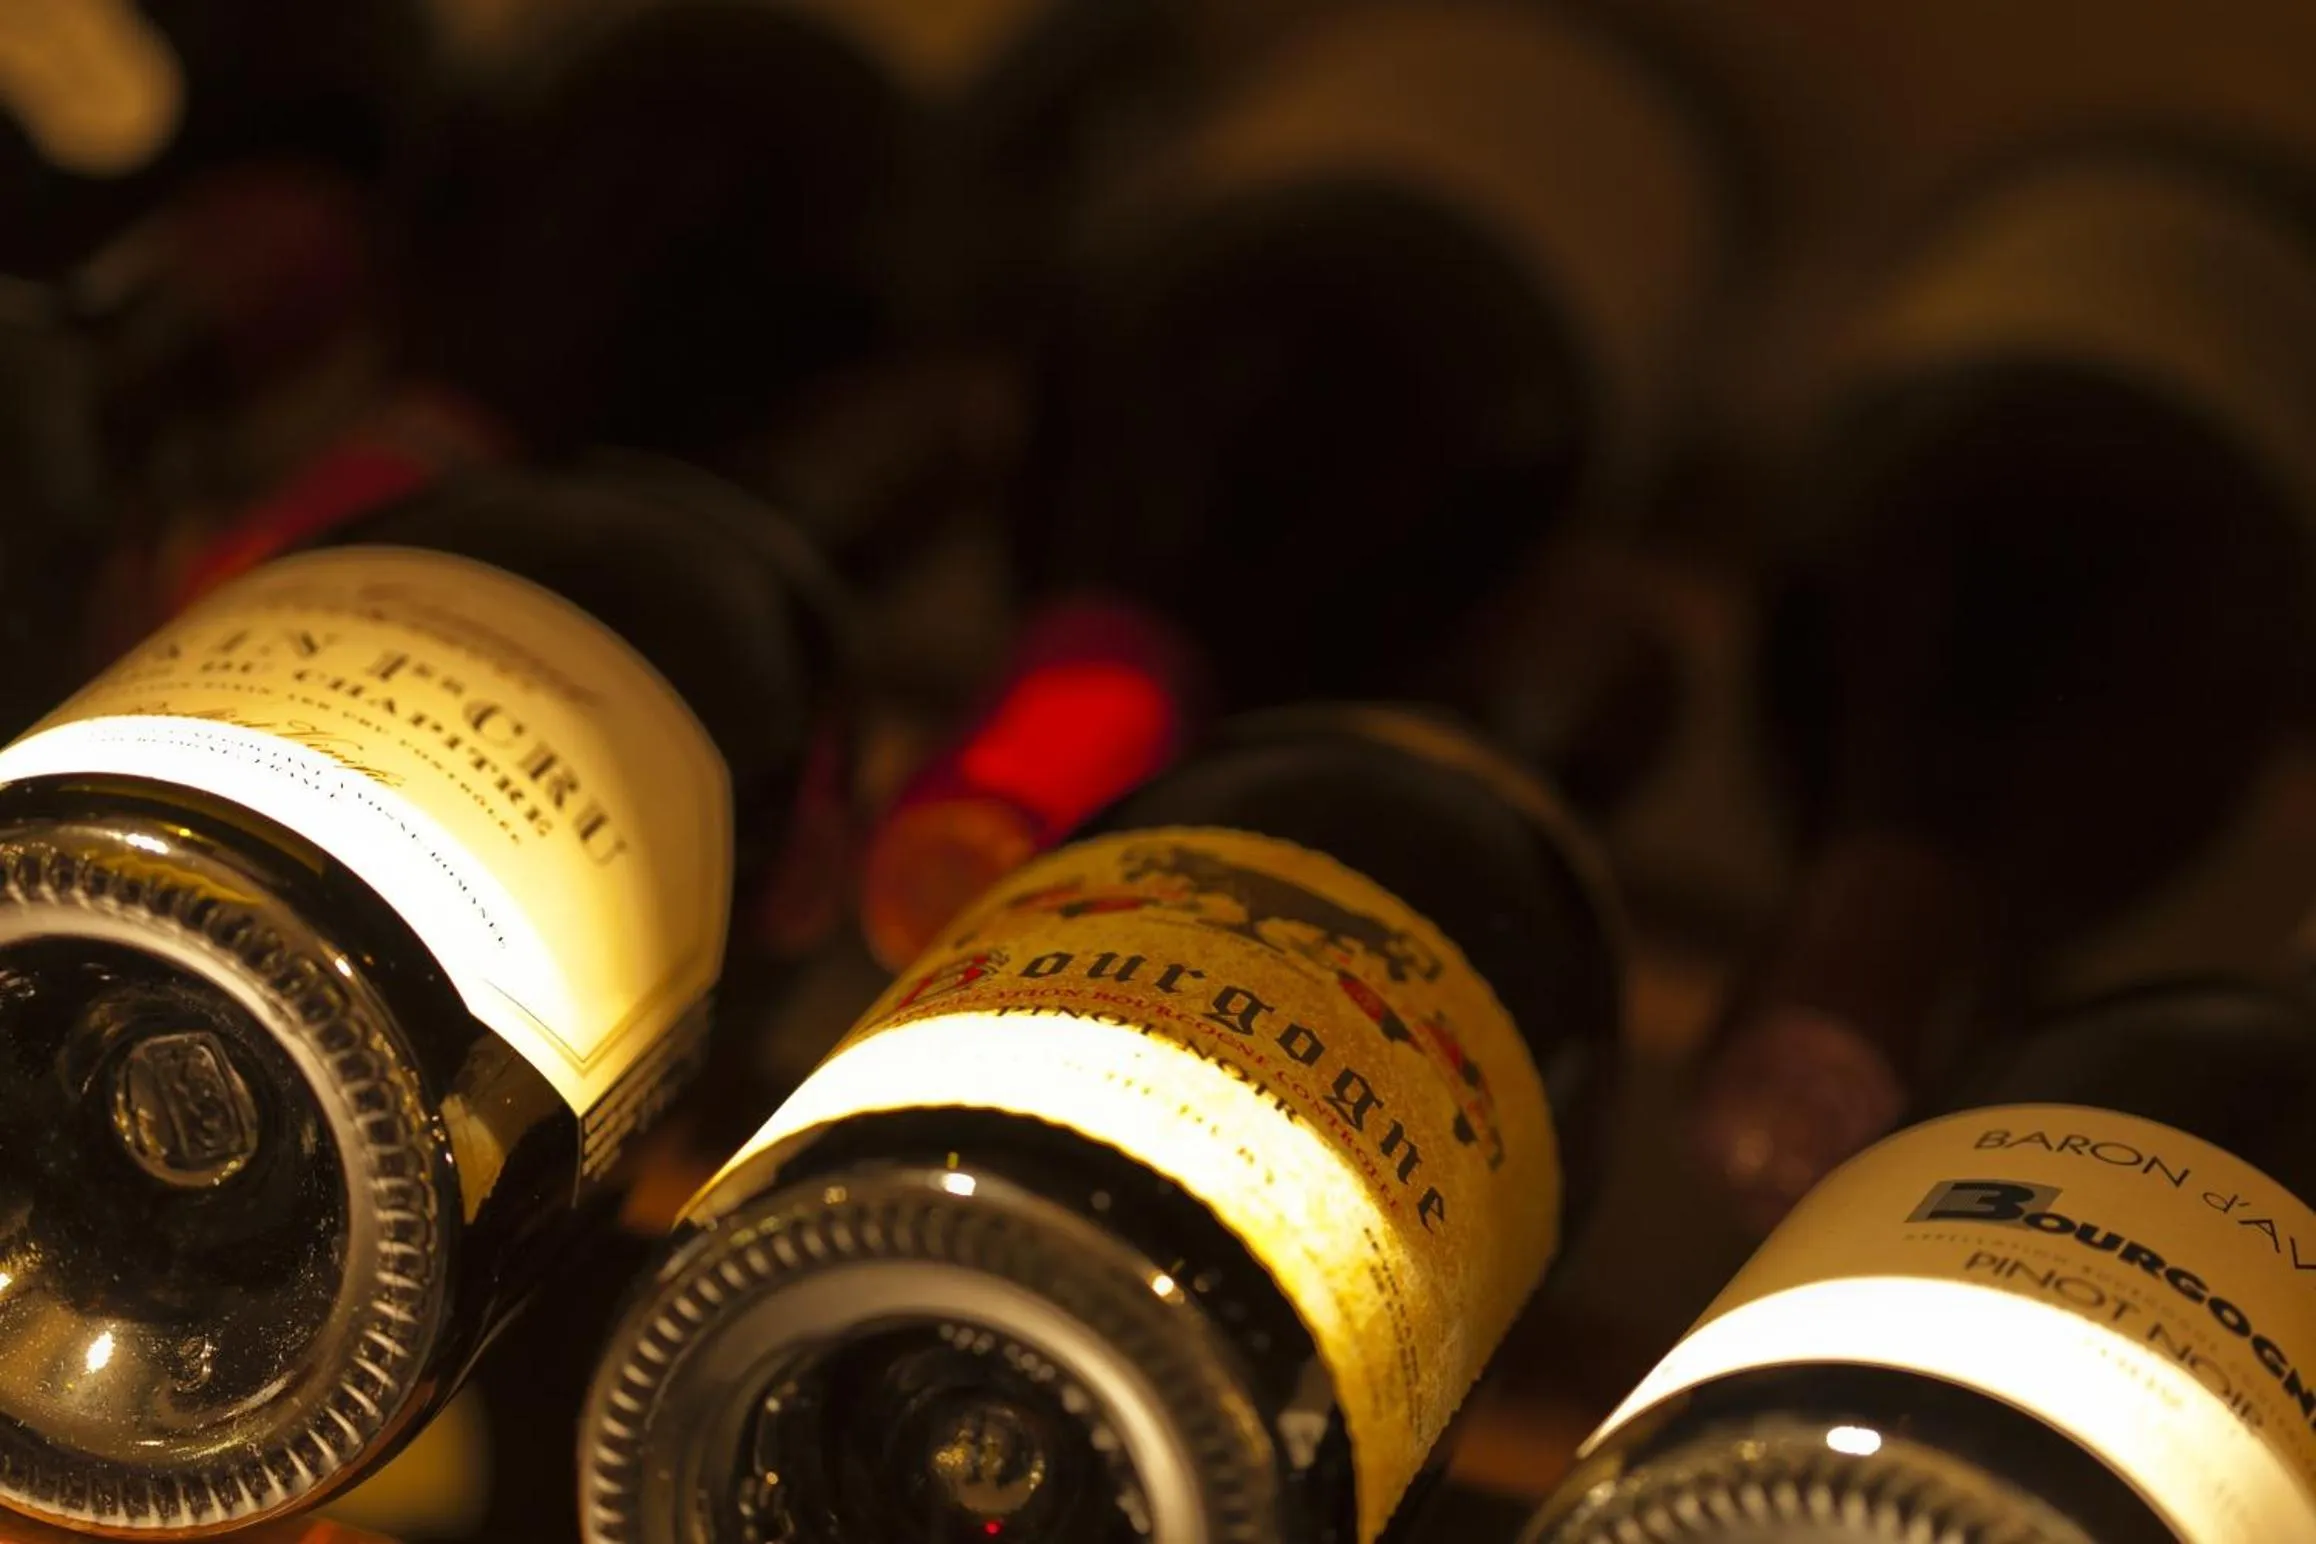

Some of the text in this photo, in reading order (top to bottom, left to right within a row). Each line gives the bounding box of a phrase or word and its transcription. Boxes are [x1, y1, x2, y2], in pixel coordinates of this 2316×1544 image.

[1973, 1127, 2192, 1188] BARON
[1925, 1181, 2316, 1434] BOURGOGN
[1963, 1248, 2142, 1322] PINOT
